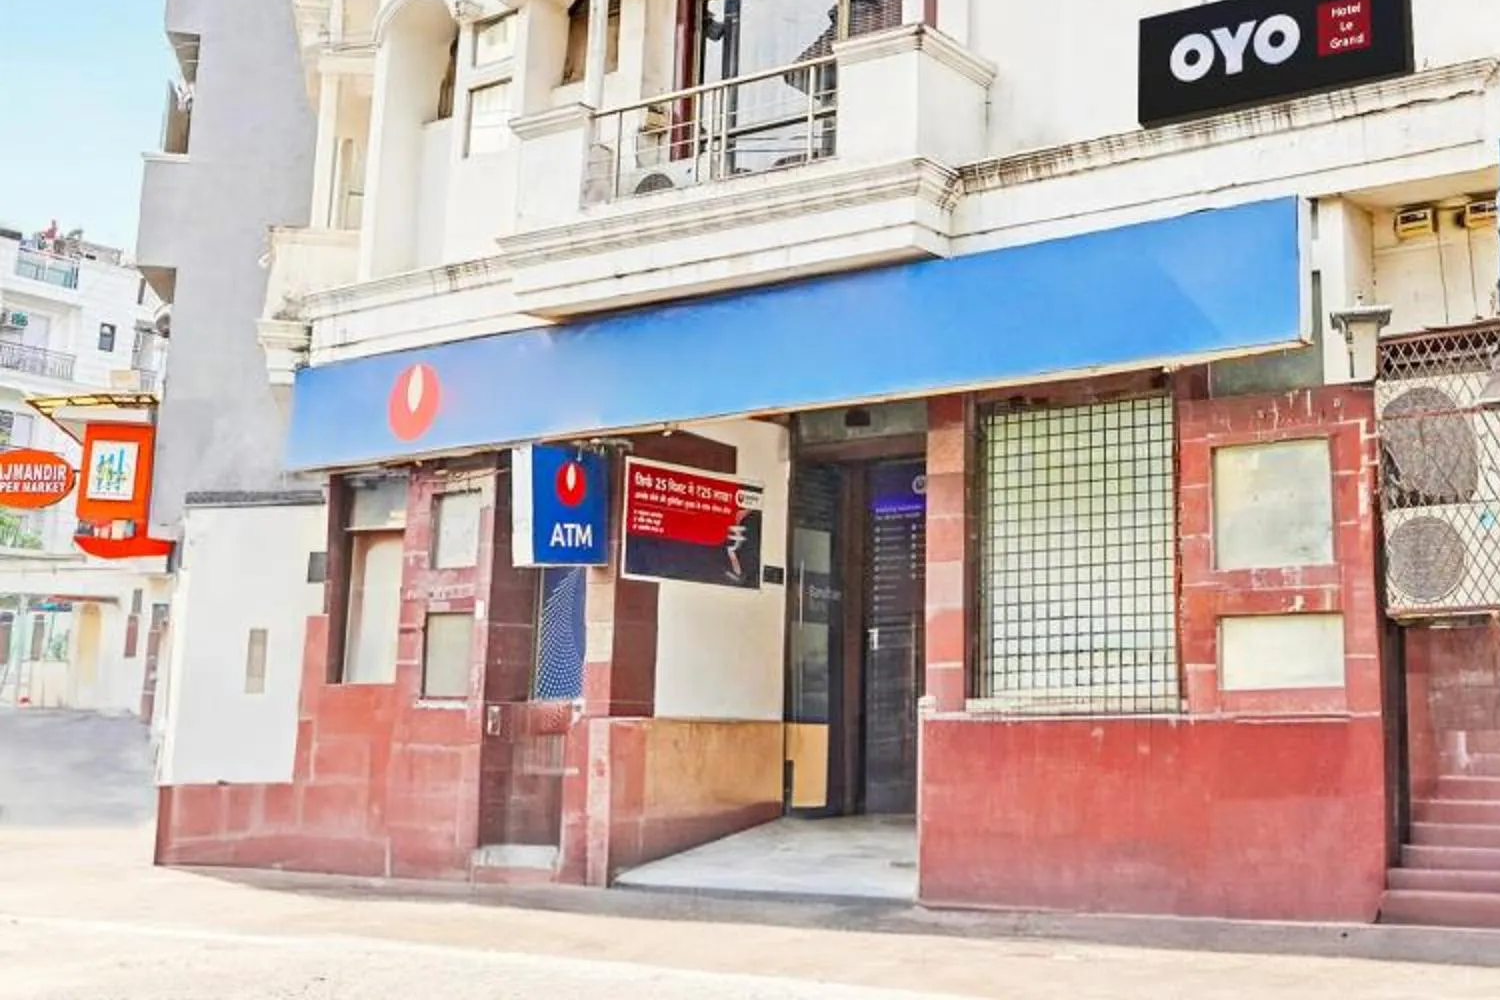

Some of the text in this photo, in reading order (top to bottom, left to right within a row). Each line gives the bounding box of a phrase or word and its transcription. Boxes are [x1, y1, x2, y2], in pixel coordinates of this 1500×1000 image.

[1331, 2, 1361, 19] Hotel
[1339, 21, 1353, 33] Le
[1169, 13, 1301, 82] OYO
[1329, 33, 1365, 49] Grand
[23, 481, 65, 493] MARKET
[655, 477, 667, 491] 25
[550, 523, 593, 548] ATM
